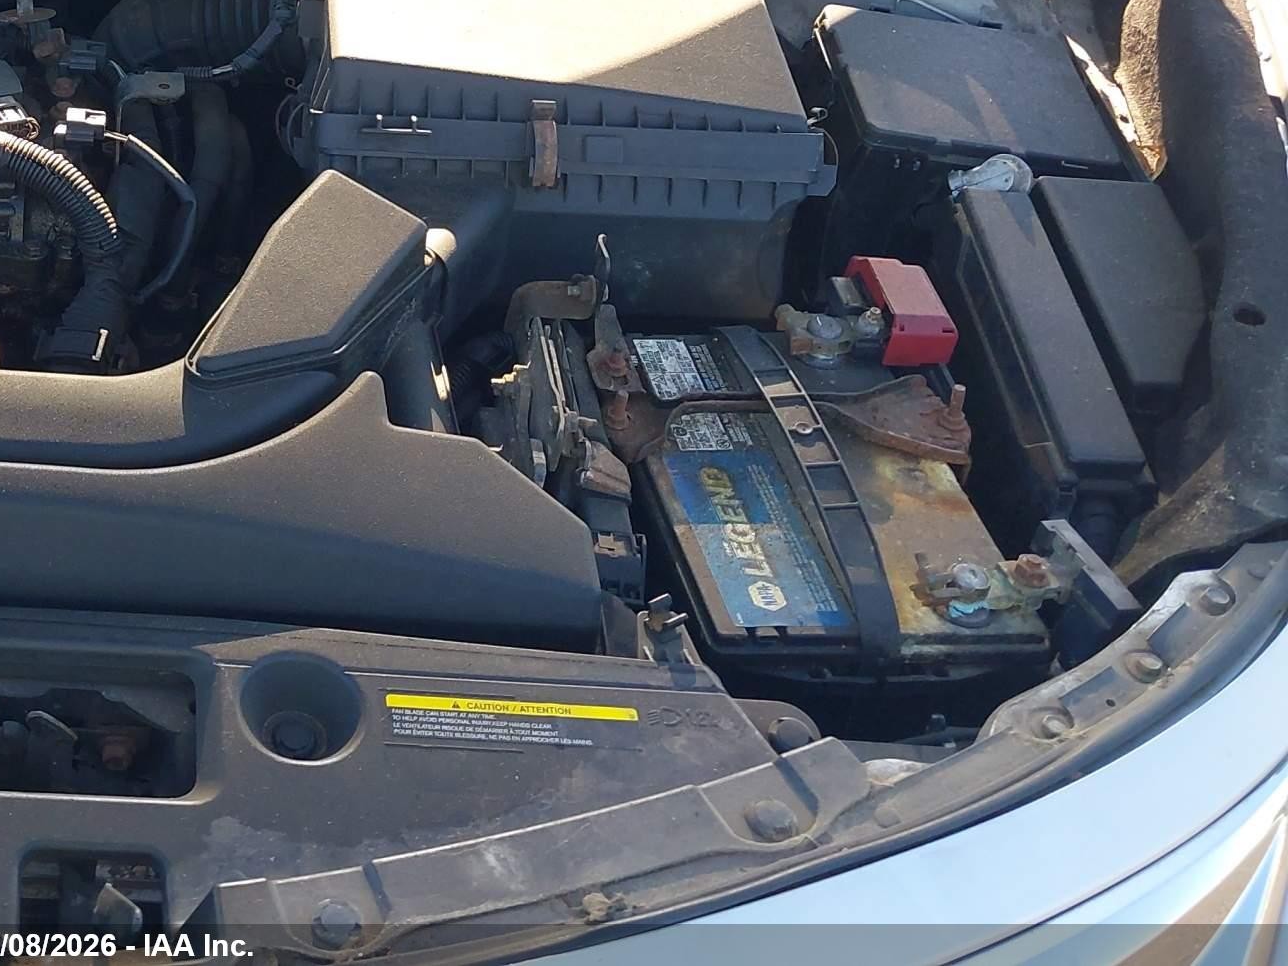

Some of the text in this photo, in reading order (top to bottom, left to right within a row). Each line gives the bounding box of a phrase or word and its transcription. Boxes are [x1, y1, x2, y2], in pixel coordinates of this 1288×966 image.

[700, 466, 774, 578] LEGEND
[466, 702, 509, 712] CAUTION
[519, 705, 572, 715] ATTENTION
